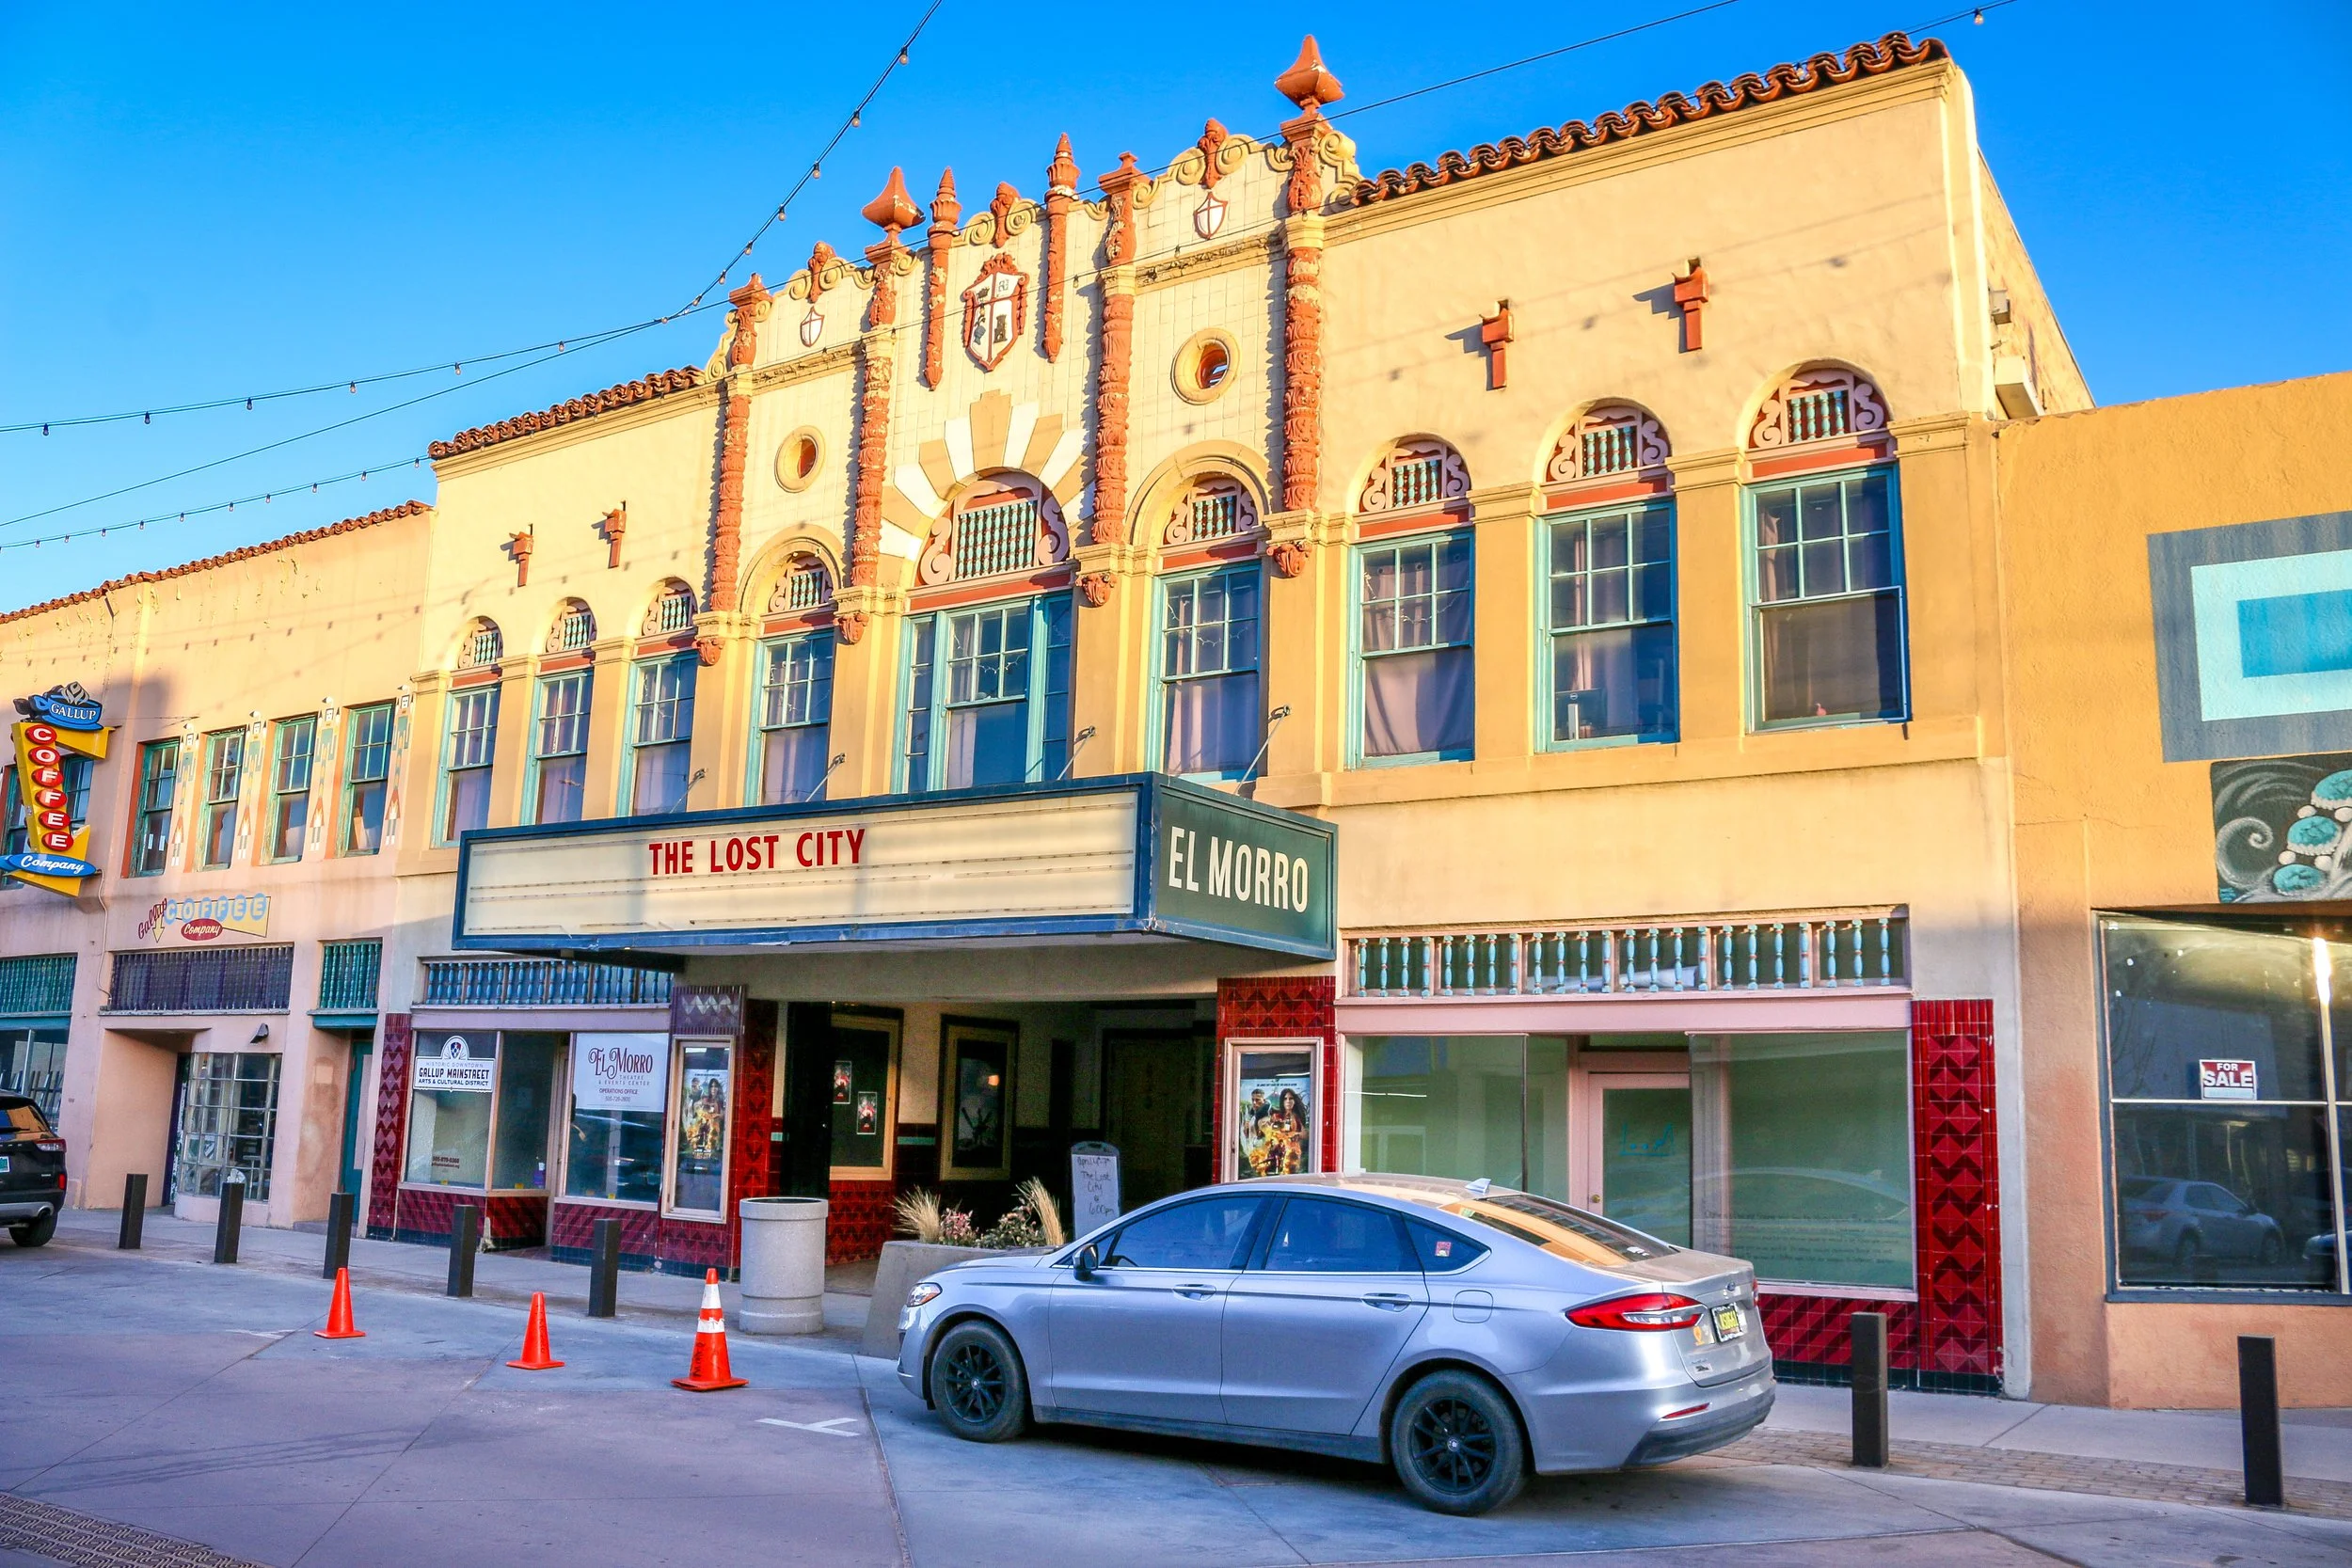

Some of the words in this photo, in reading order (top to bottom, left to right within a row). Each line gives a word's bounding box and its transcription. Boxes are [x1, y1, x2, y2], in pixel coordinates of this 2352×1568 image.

[51, 703, 97, 721] GALLUP
[32, 727, 68, 847] COFFEE
[648, 841, 694, 876] THE
[710, 835, 780, 874] LOST
[796, 829, 866, 868] CITY
[21, 855, 86, 874] Company
[1168, 826, 1200, 893] EL
[1208, 835, 1309, 913] MORRO
[138, 897, 167, 940] Gallup
[166, 896, 264, 921] COFFEE
[183, 923, 221, 937] Company
[419, 1068, 444, 1078] GALLUP
[447, 1069, 490, 1080] MAINSTREET
[2217, 1063, 2238, 1071] FOR
[2202, 1070, 2253, 1087] SALE
[1080, 1170, 1093, 1181] The
[1094, 1170, 1112, 1182] Lost
[1087, 1180, 1104, 1196] City
